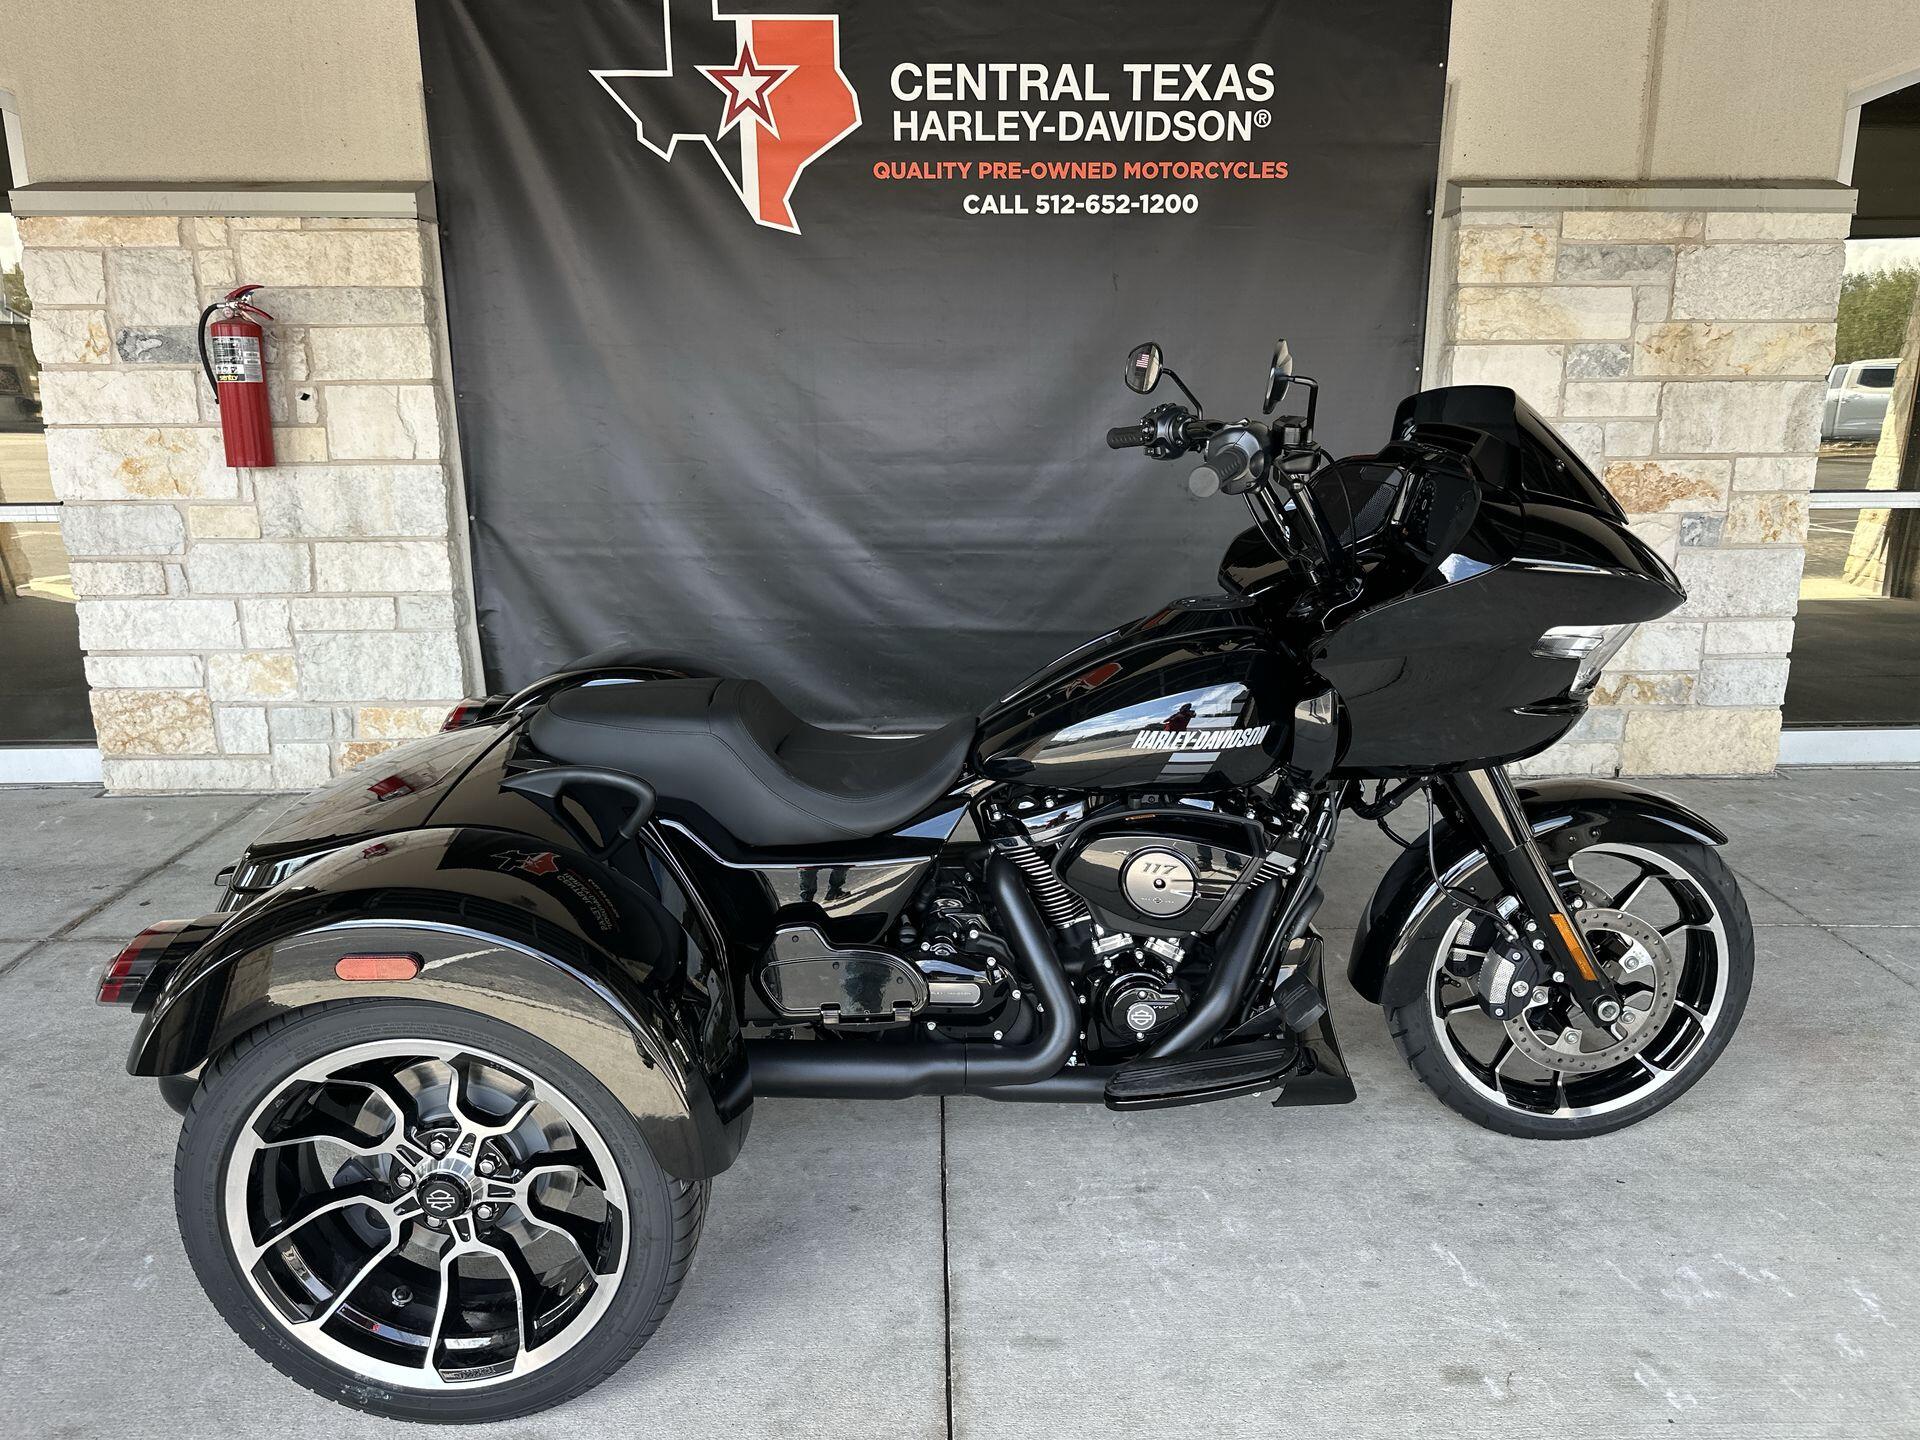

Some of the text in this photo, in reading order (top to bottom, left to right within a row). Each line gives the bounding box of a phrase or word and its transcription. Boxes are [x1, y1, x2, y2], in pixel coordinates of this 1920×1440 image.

[889, 62, 1276, 103] CENTRAL TEXAS
[872, 161, 1289, 181] QUALITY PRE-OWNED MOTORCYCLES
[962, 194, 1199, 215] CALL 512-652-1200
[1131, 725, 1271, 750] HARLEY-DAVIDSON
[1143, 862, 1178, 875] 117
